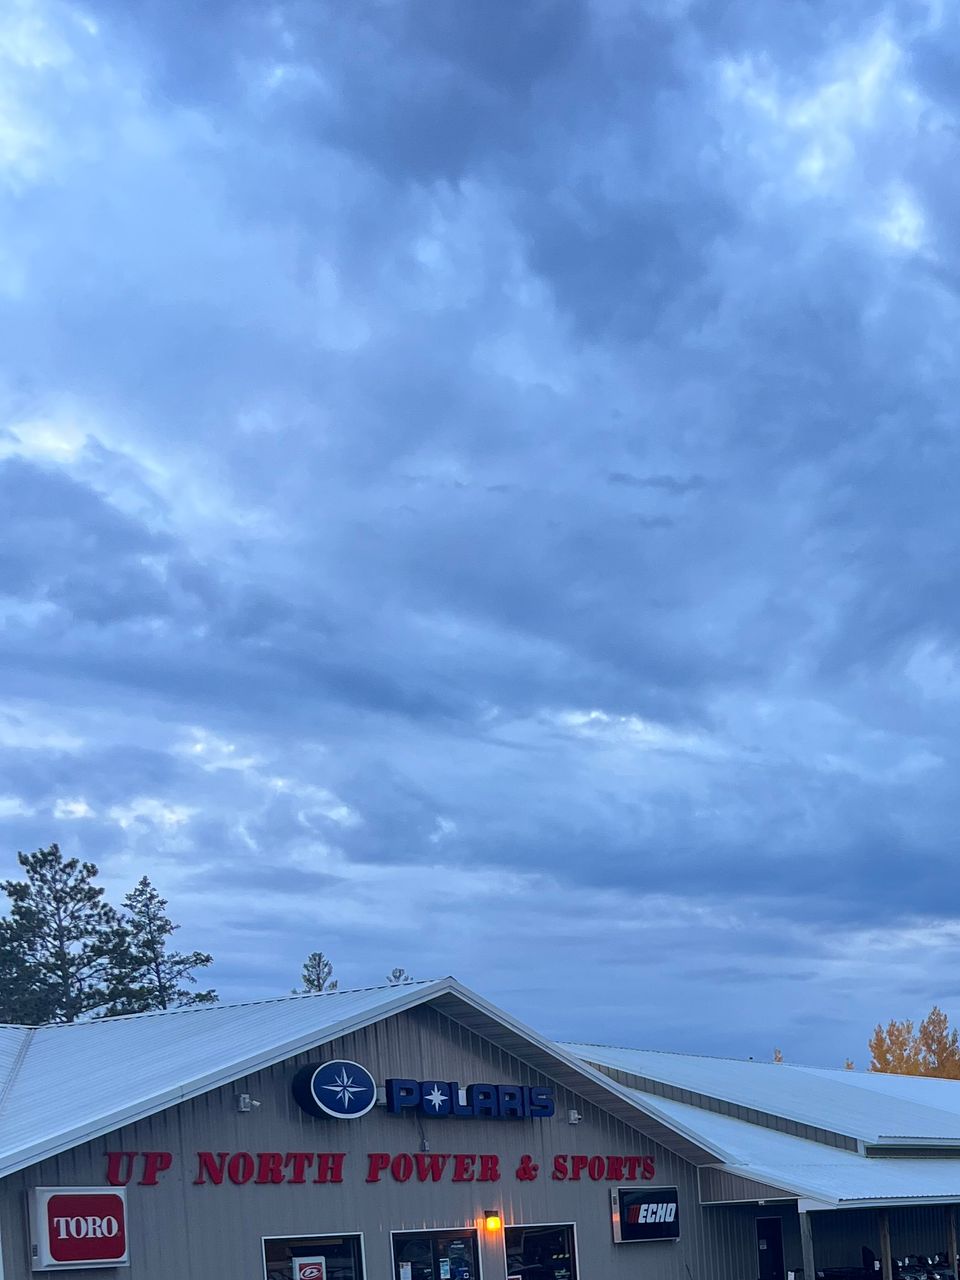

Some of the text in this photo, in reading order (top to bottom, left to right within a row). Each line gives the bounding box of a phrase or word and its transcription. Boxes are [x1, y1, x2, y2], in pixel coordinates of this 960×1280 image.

[386, 1079, 555, 1118] POLARIS
[105, 1151, 656, 1186] UP NORTH POWER & SPORTS
[53, 1215, 119, 1239] TORO
[638, 1203, 676, 1223] ECHO
